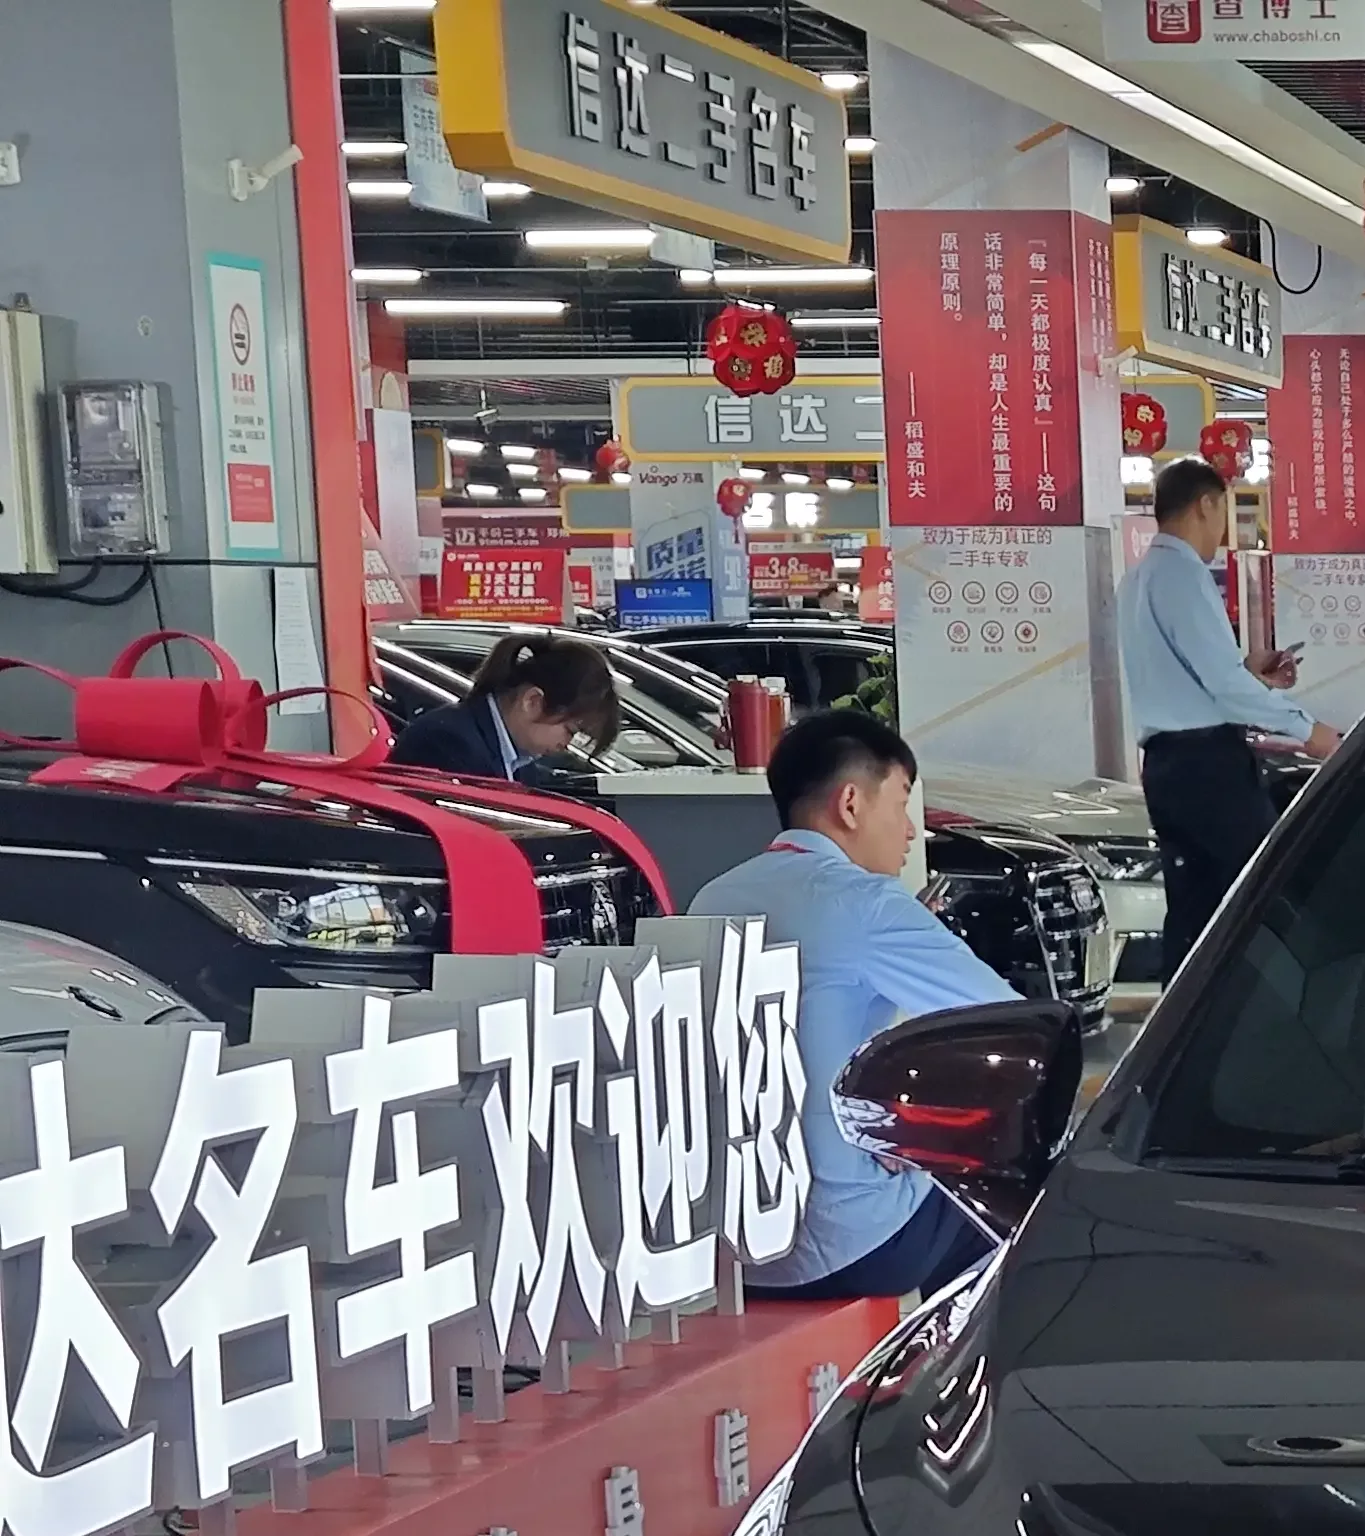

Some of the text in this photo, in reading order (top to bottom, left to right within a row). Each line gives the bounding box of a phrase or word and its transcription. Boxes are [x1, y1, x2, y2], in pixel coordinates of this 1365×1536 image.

[1213, 28, 1341, 43] www.chaboshi.cn
[563, 10, 817, 212] 信达二手名车
[704, 395, 884, 444] 信达二
[922, 527, 1053, 546] 致力于成为真正的
[948, 549, 1030, 568] 二手车专家
